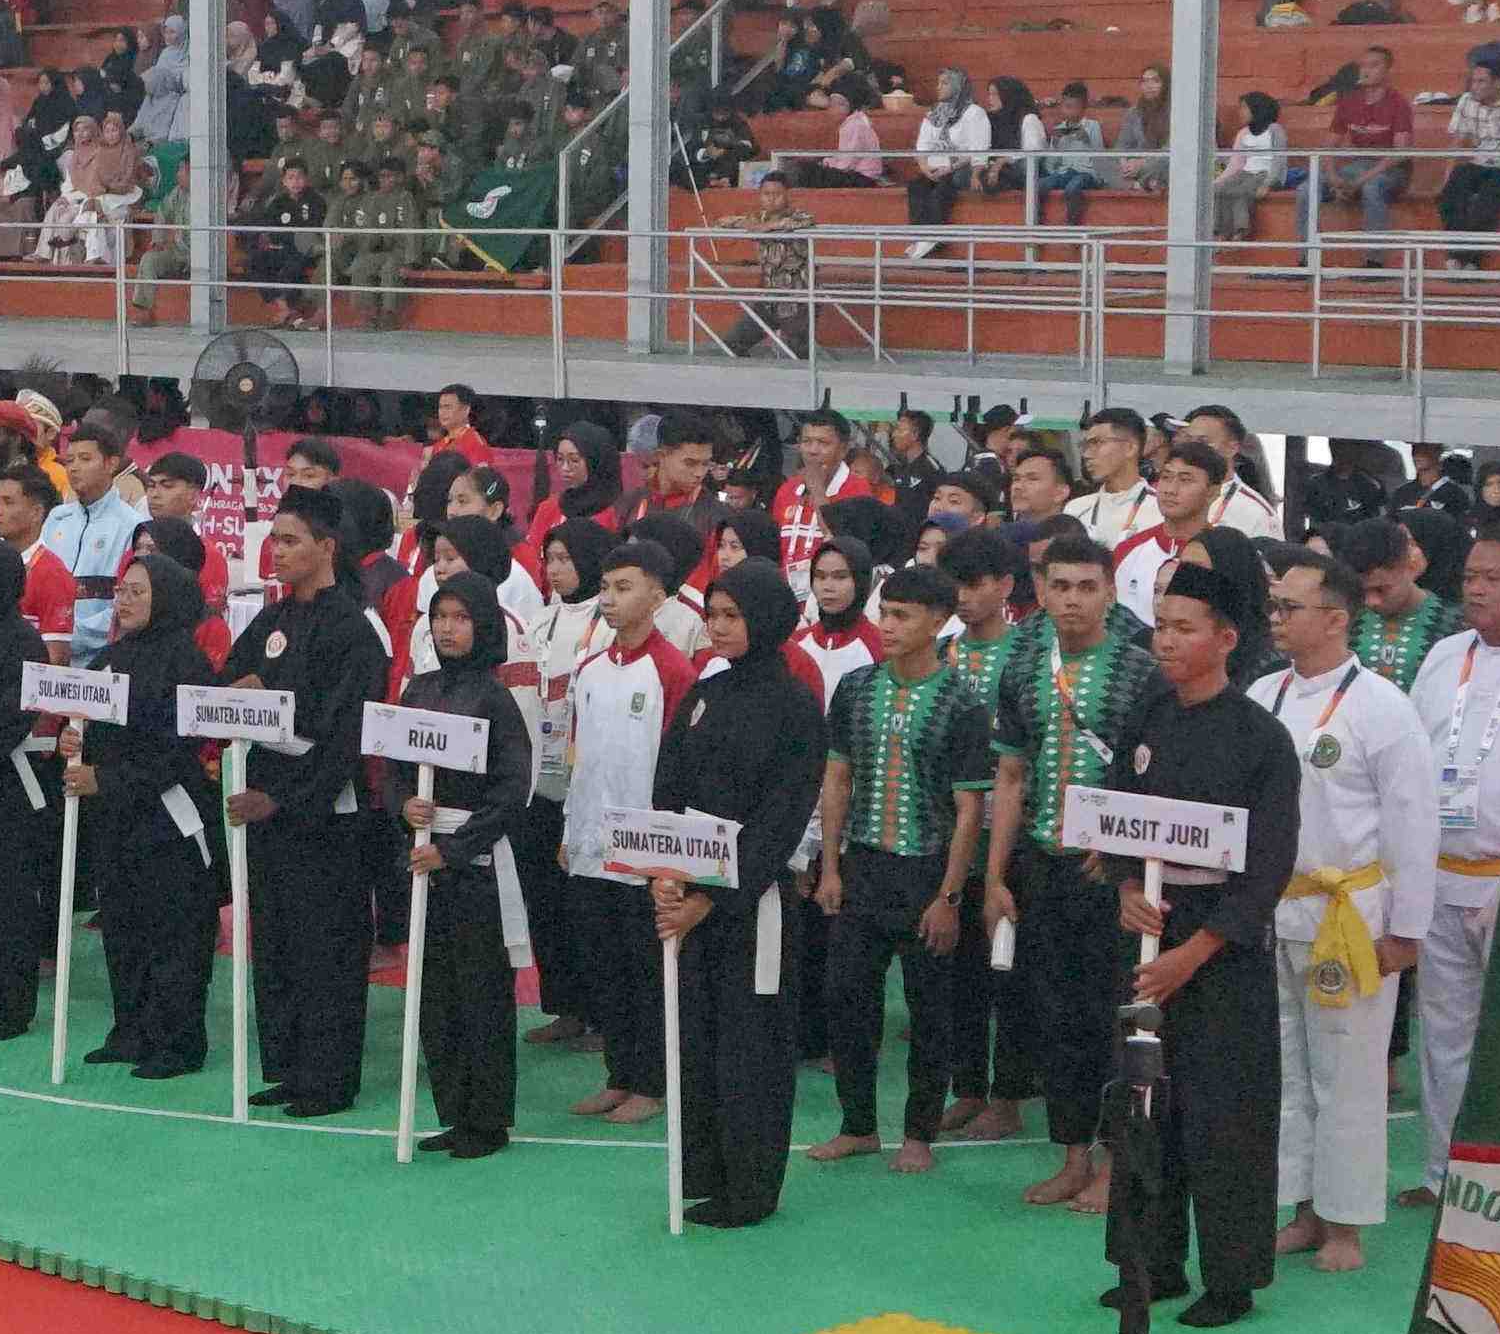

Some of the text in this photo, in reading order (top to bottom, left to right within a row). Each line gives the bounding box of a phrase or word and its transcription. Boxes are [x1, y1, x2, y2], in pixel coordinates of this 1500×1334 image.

[38, 679, 112, 705] SULAWESI UTARA
[195, 704, 280, 729] SUMATERA SELATAN
[407, 728, 448, 752] RIAU
[1099, 813, 1209, 849] WASIT JURI
[612, 829, 732, 862] SUMATERA UTARA
